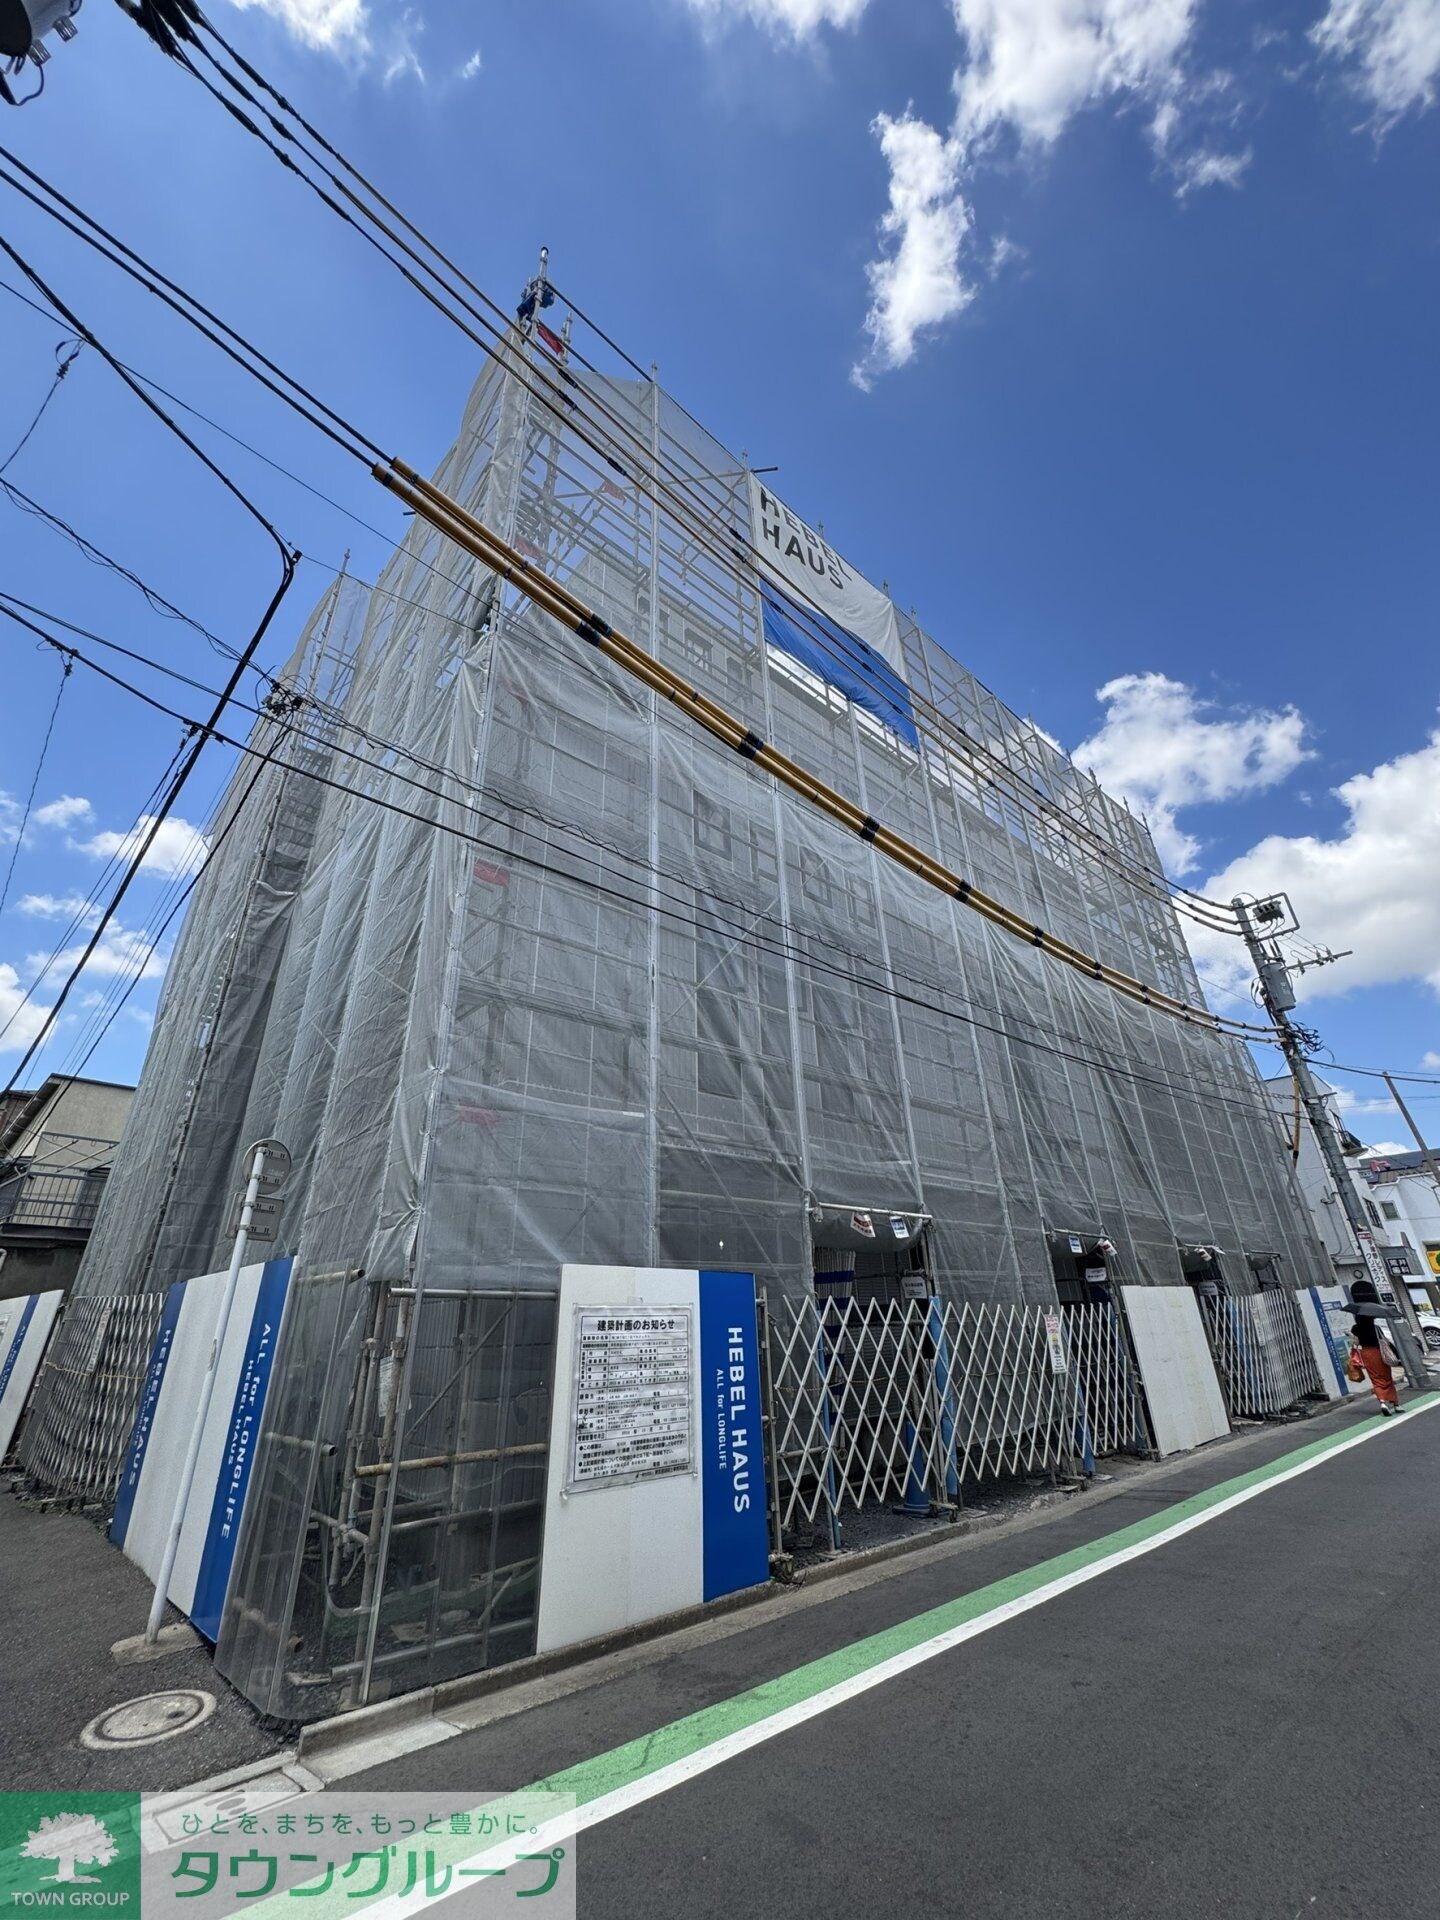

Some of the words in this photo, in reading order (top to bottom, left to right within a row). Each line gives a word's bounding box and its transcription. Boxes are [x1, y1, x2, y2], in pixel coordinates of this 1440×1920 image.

[760, 486, 853, 581] HEBEL
[761, 515, 845, 590] HAUS
[256, 1323, 271, 1364] ALL
[597, 1319, 675, 1332] 建築計画のお知らせ
[149, 1329, 171, 1402] HEBEL
[237, 1359, 254, 1414] HEBEL
[249, 1376, 260, 1407] for
[716, 1368, 724, 1389] ALL
[727, 1327, 746, 1421] HEBEL
[128, 1416, 149, 1486] HAUS
[227, 1418, 241, 1465] HAUS
[717, 1413, 727, 1471] LONGLIFE
[731, 1428, 751, 1514] HAUS
[221, 1416, 253, 1539] LONGLIFE
